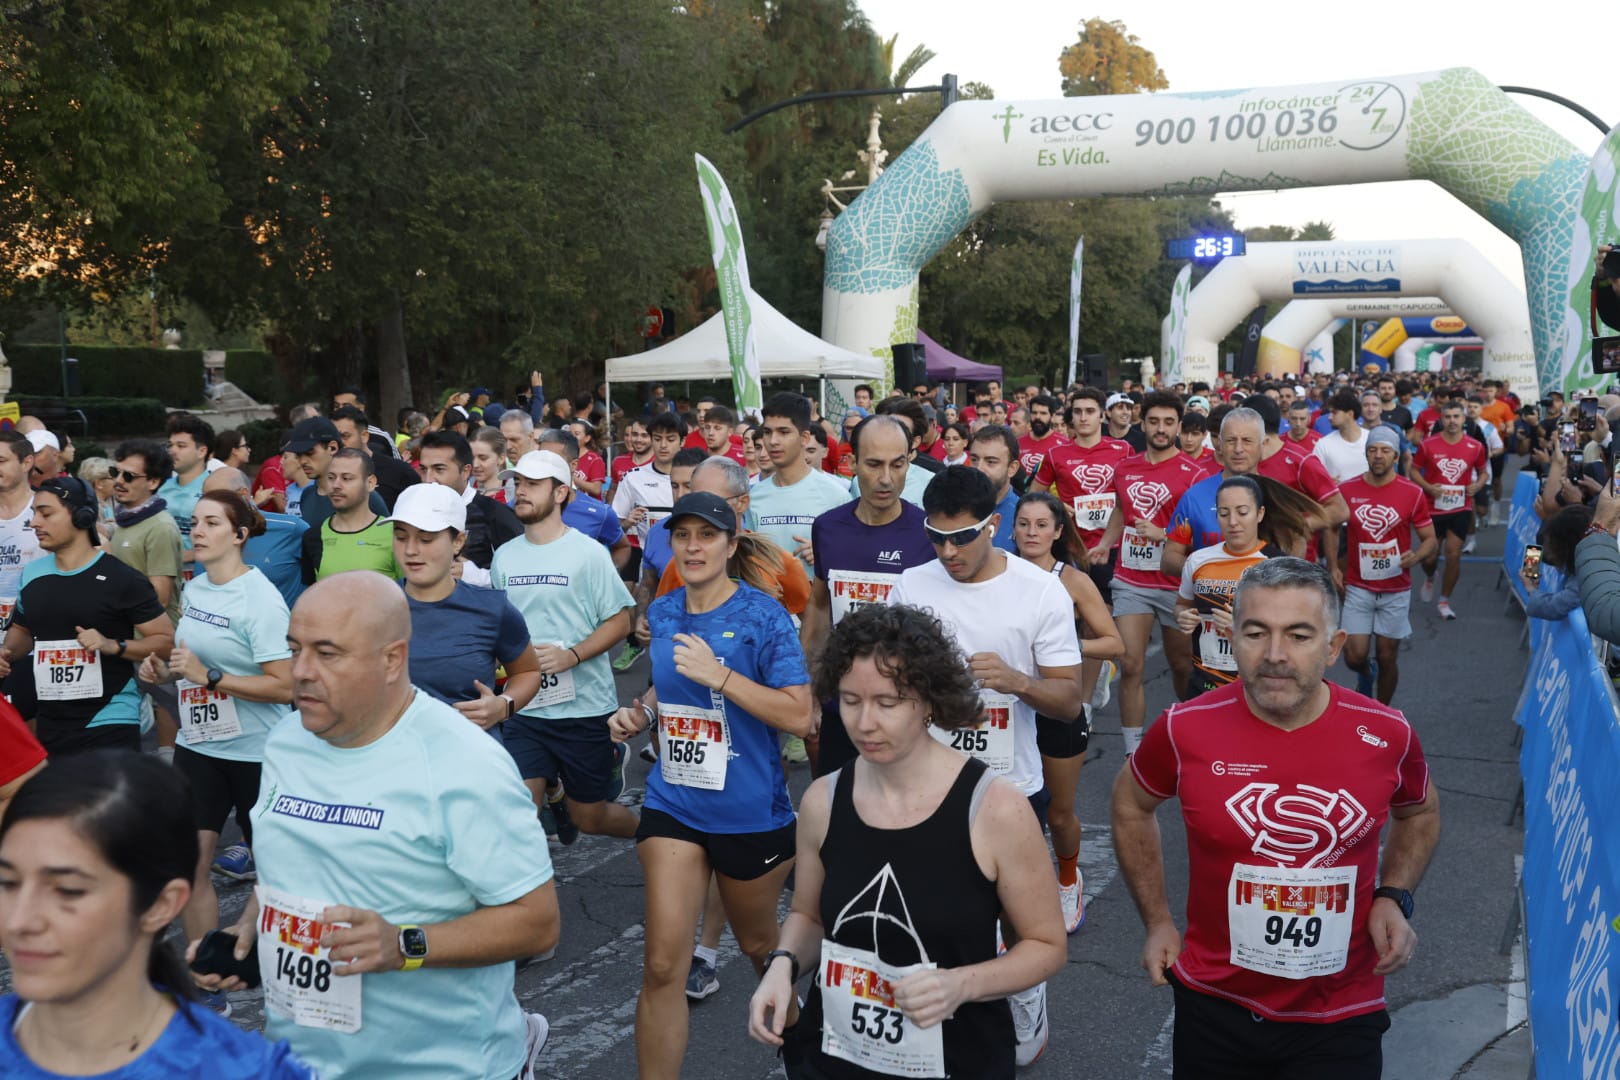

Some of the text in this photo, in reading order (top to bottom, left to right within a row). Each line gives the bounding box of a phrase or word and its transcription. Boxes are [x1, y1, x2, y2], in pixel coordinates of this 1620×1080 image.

[1351, 85, 1376, 98] 24
[1239, 94, 1342, 113] infocáncer
[1030, 112, 1114, 134] aecc
[1135, 106, 1338, 148] 900 100 036
[1256, 135, 1337, 153] Llámame.
[1037, 146, 1110, 166] Es Vida.
[1088, 509, 1107, 521] 287
[1129, 546, 1154, 559] 1445
[538, 575, 547, 584] LA
[49, 665, 84, 684] 1857
[190, 703, 219, 726] 1579
[950, 729, 989, 752] 265
[667, 739, 708, 765] 1585
[275, 796, 328, 821] CEMENTOS
[326, 806, 341, 823] LA
[1345, 816, 1377, 848] SOLIDARIA
[1264, 915, 1322, 948] 949
[276, 947, 332, 993] 1498
[851, 1001, 904, 1045] 533
